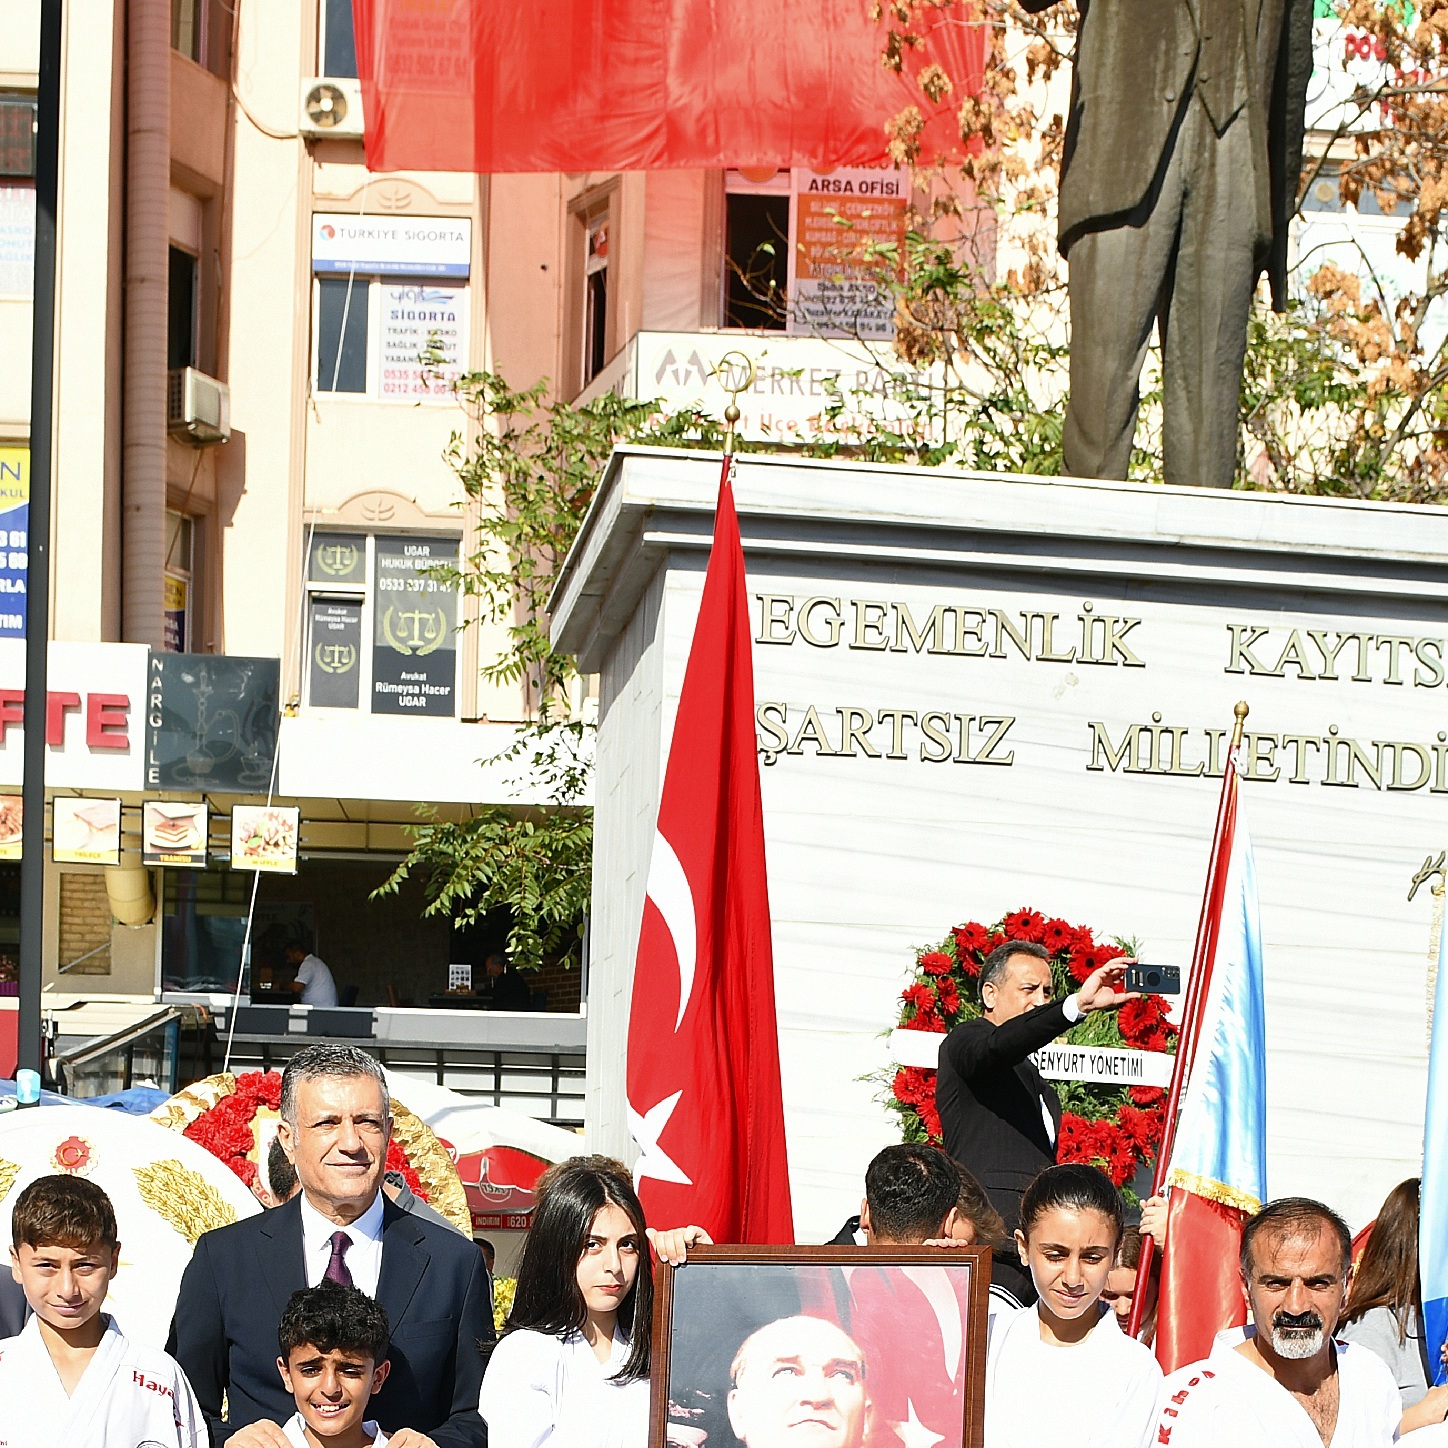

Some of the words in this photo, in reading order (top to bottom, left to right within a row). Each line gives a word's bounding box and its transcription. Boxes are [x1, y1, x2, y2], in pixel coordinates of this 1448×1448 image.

[809, 178, 854, 193] ARSA
[858, 177, 899, 195] OFİSİ
[380, 579, 405, 592] 0533
[755, 594, 1146, 668] EGEMENLİK
[375, 682, 420, 697] Rümeysa
[421, 684, 451, 696] Hacer
[149, 658, 163, 784] NARGİLE
[755, 702, 1016, 766] ŞARTSIZ
[1032, 1052, 1086, 1075] SENYURT
[1089, 1051, 1143, 1077] YÖNETİMİ
